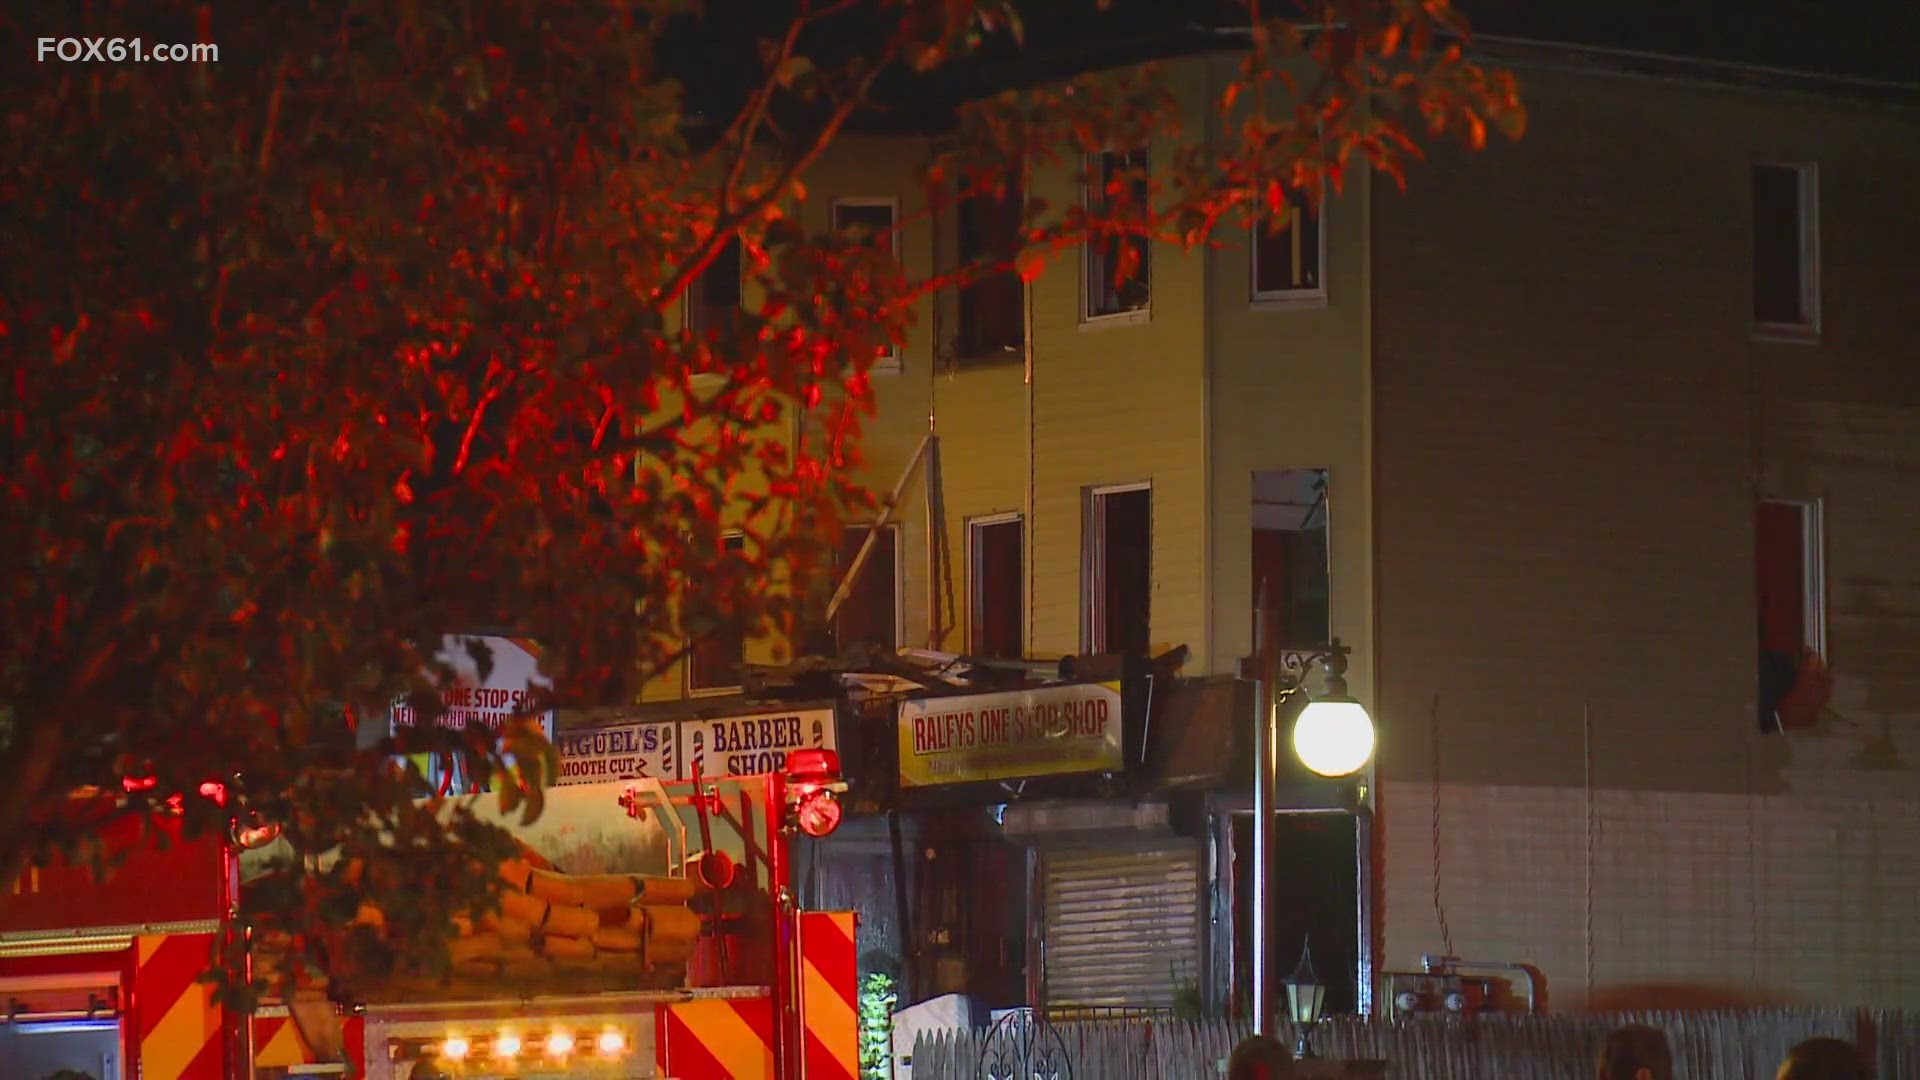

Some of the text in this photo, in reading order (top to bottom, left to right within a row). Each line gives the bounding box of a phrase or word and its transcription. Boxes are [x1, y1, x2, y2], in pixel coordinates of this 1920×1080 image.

[474, 688, 509, 709] STOP
[712, 717, 804, 752] BARBER
[914, 698, 1109, 752] RALFYS ONE STOP SHOP
[560, 759, 607, 777] MOOTH
[727, 751, 786, 777] SHOP
